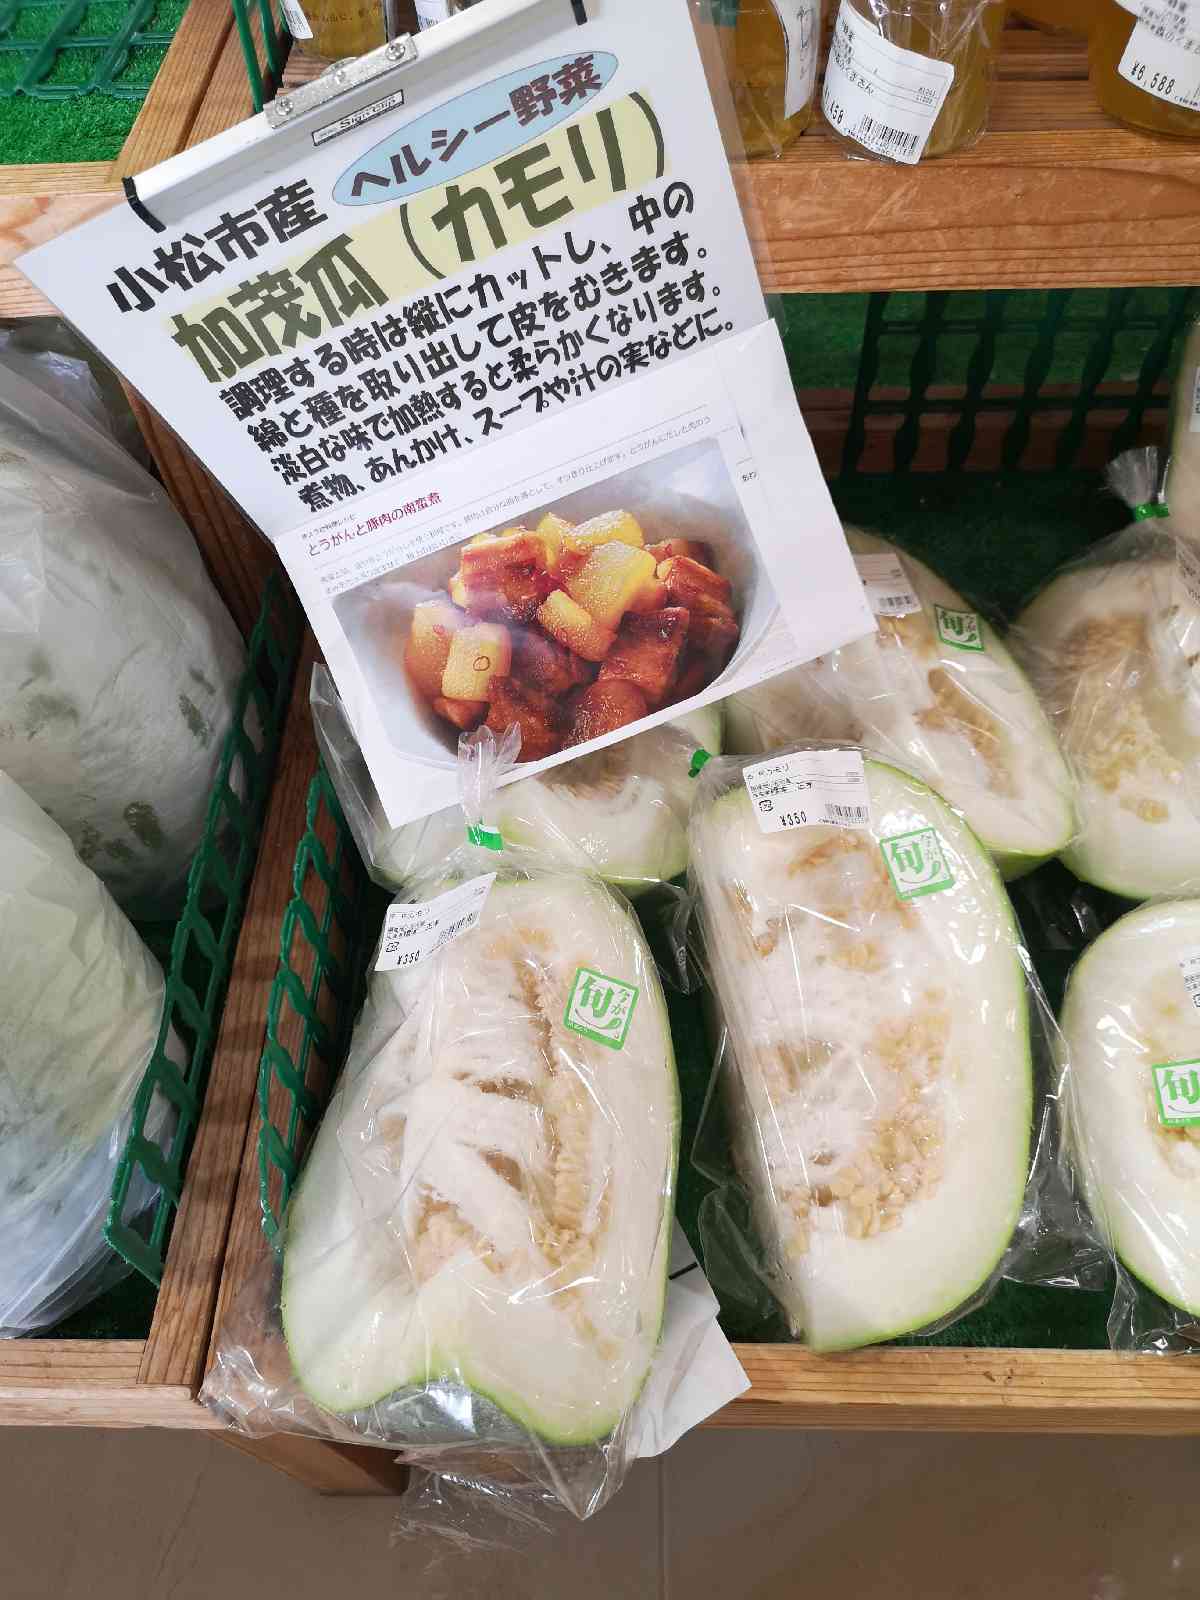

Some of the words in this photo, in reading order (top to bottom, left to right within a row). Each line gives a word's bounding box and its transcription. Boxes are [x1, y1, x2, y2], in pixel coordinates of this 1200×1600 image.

[351, 54, 603, 197] ヘルシー野菜
[1131, 63, 1175, 95] ¥6,588
[106, 178, 328, 313] 小松市産
[247, 230, 708, 453] 綿と種を取り出して皮をむきます。
[270, 269, 721, 486] 淡白な味で加熱すると柔らかくなります。
[308, 491, 442, 557] とうがんと豚肉の南蛮煮
[779, 811, 807, 826] ¥350
